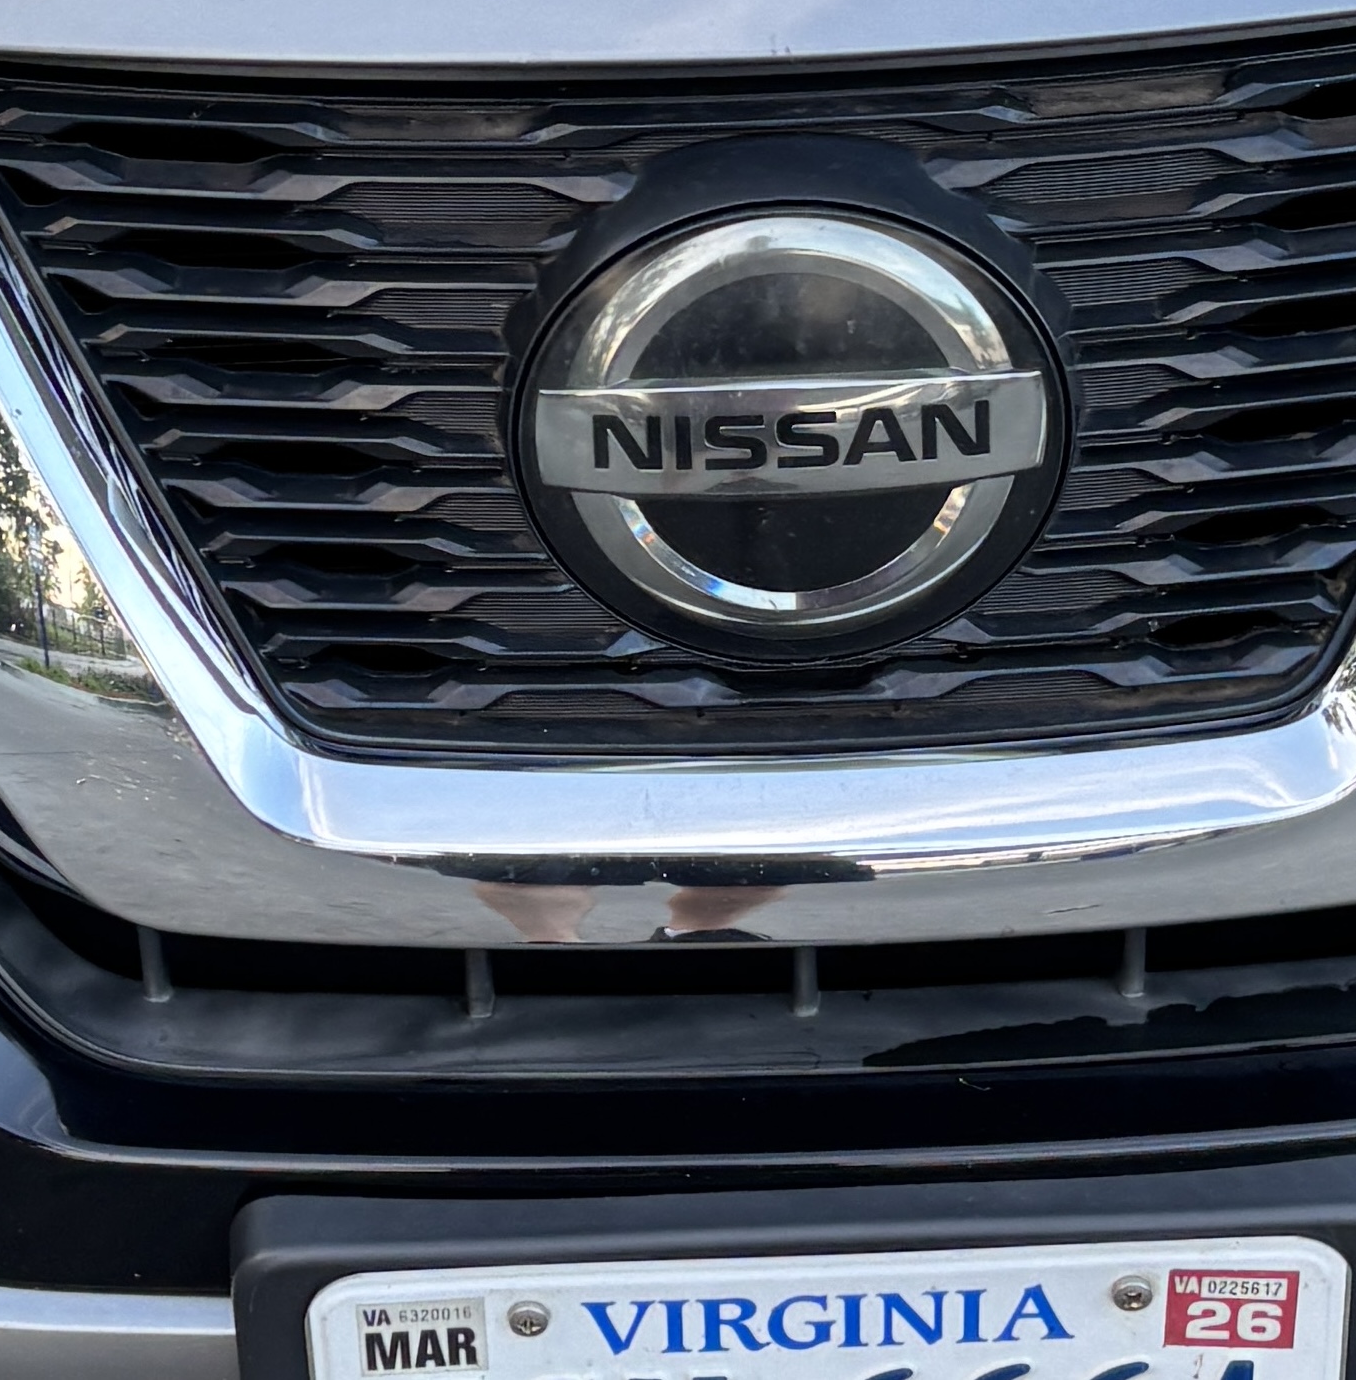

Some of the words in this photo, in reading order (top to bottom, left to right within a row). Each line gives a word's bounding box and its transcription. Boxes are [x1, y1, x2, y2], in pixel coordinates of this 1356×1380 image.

[592, 399, 991, 471] NISSAN
[1174, 1276, 1199, 1294] VA
[1207, 1280, 1283, 1296] 0225617
[362, 1309, 391, 1327] VA
[399, 1306, 472, 1324] 6320016
[580, 1284, 1075, 1356] VIRGINIA
[1185, 1300, 1283, 1342] 26
[365, 1327, 478, 1371] MAR
